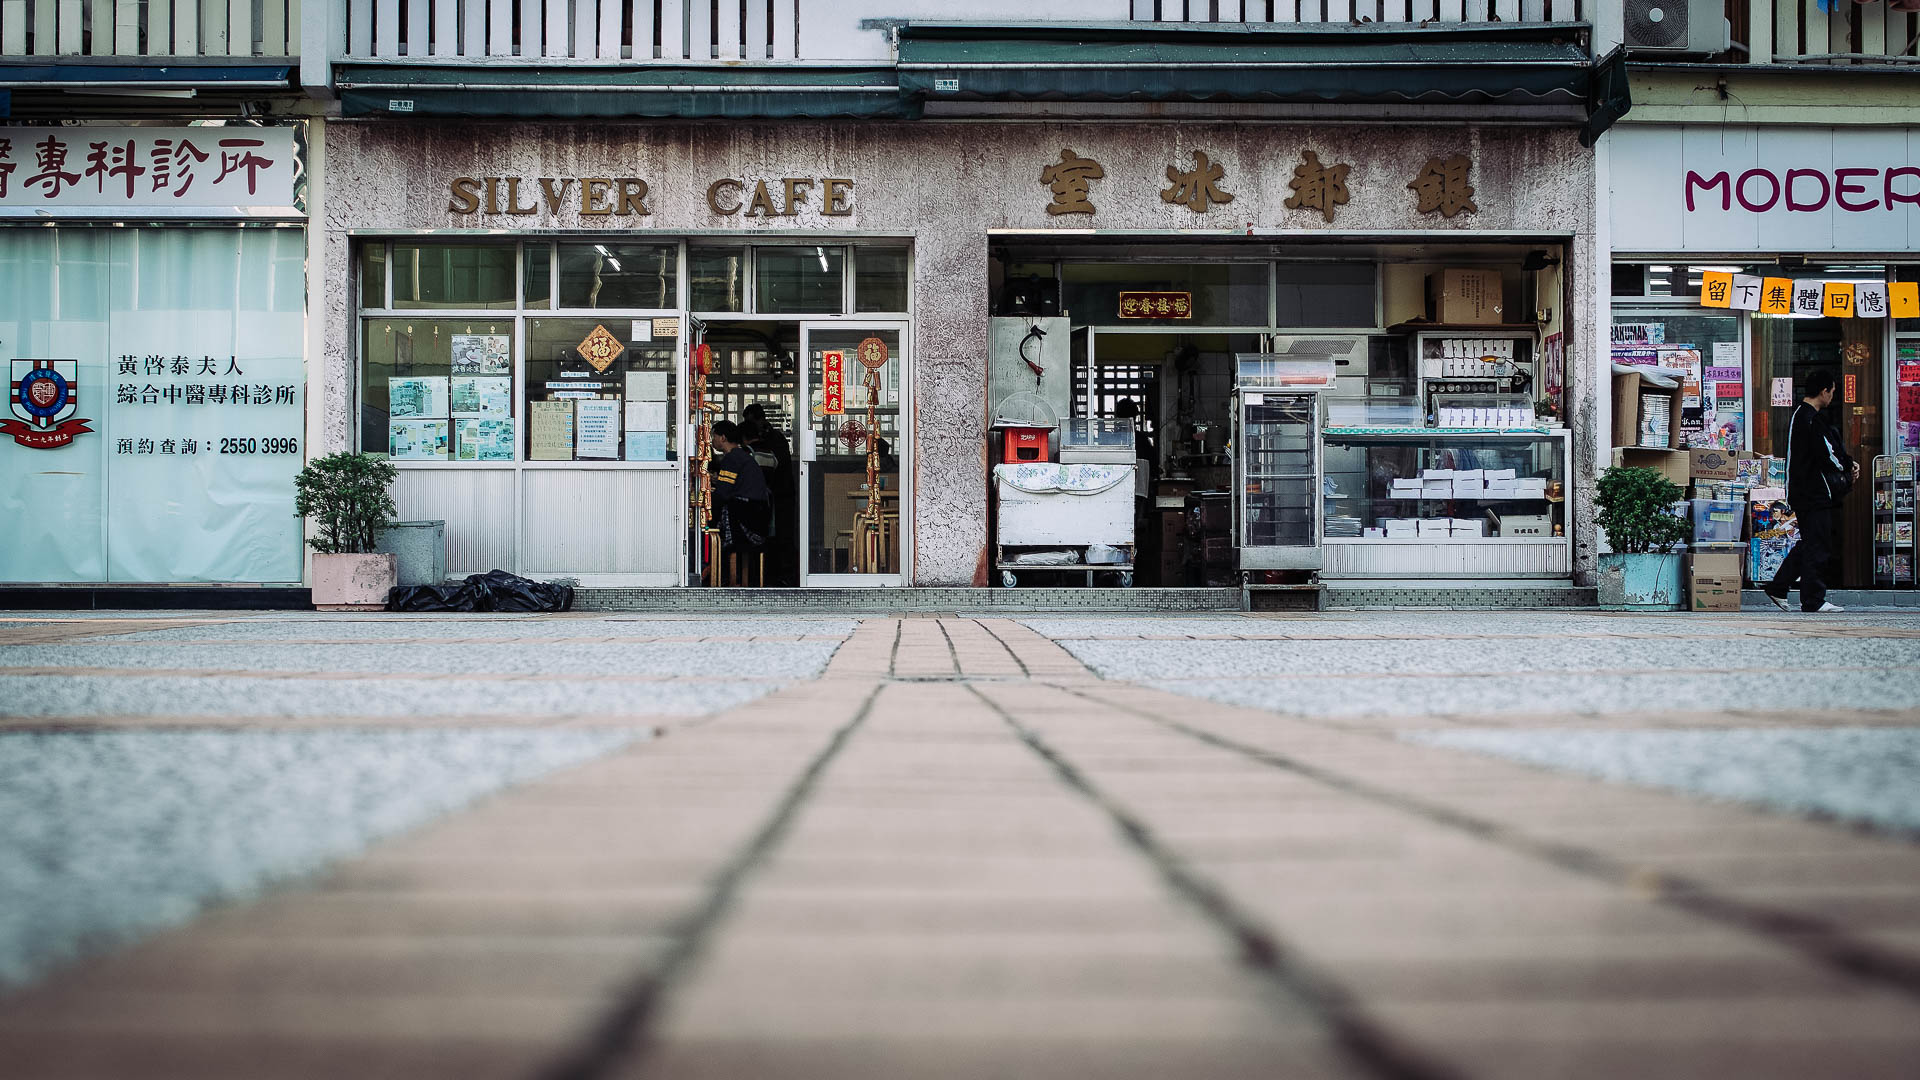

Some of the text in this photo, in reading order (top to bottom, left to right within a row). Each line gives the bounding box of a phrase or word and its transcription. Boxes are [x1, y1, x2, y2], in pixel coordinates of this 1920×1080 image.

[448, 176, 854, 217] SILVER CAFE
[1685, 166, 1920, 213] MODER
[864, 343, 882, 361] 福
[116, 383, 296, 405] 綜合中醫專科診所
[827, 355, 841, 411] 身體健康
[220, 437, 257, 454] 2550
[261, 437, 298, 454] 3996
